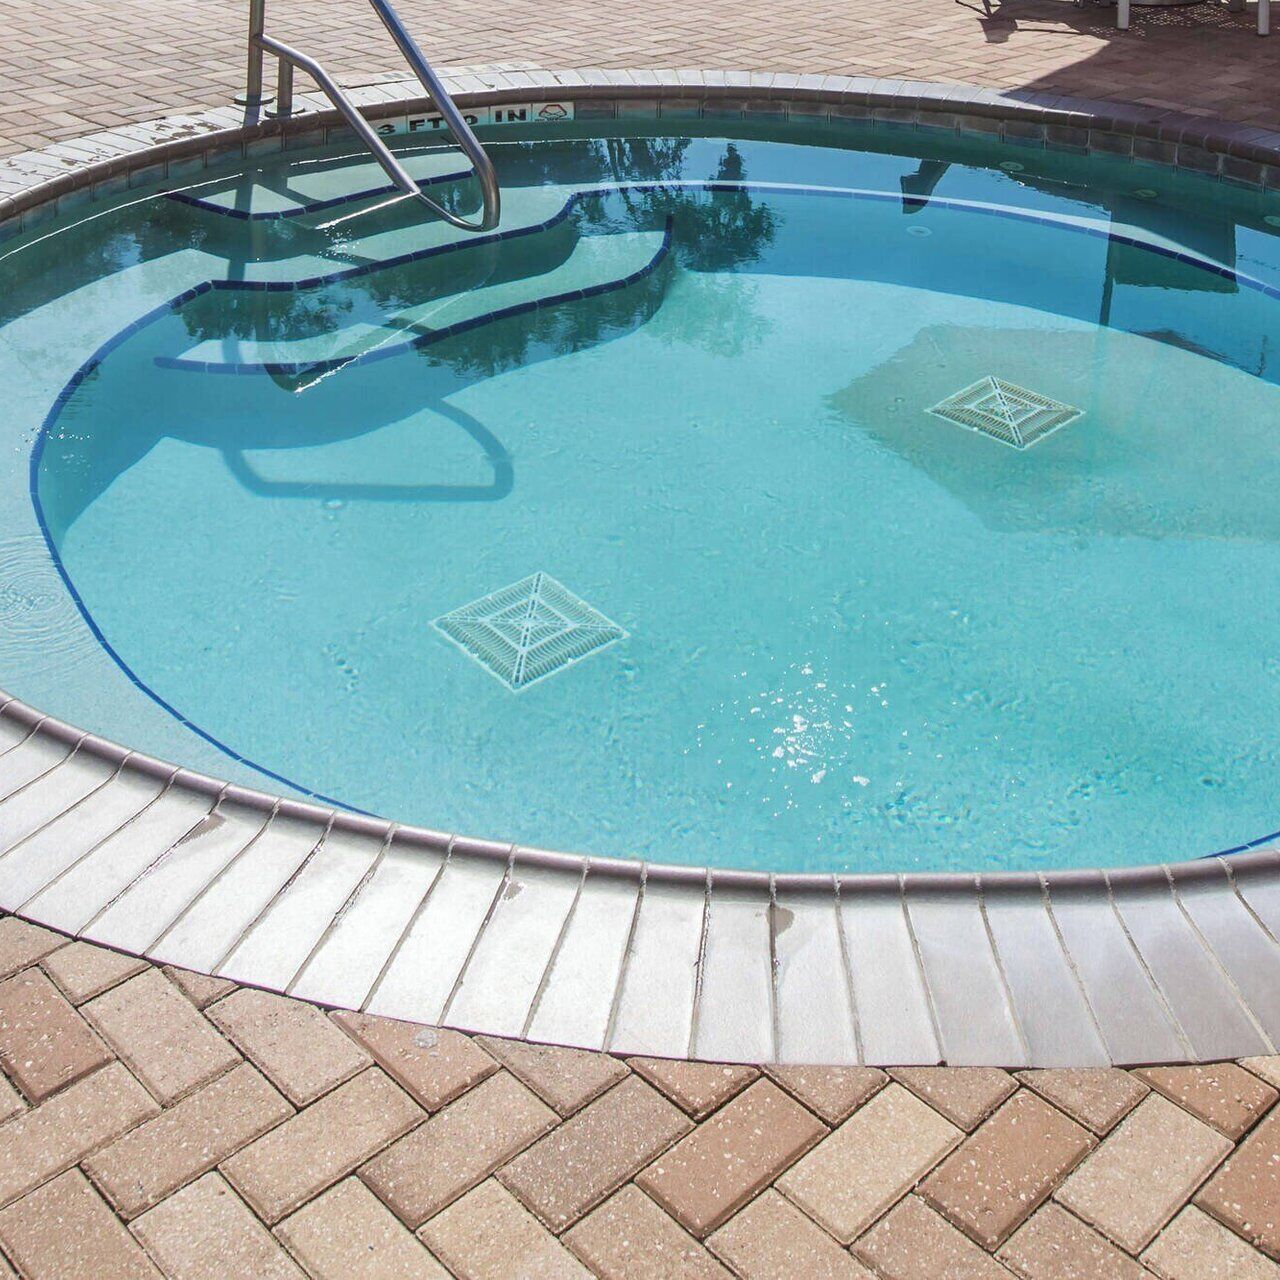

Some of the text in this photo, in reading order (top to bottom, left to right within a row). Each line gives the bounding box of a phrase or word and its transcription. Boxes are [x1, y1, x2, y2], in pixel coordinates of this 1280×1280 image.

[378, 124, 396, 134] 3
[410, 117, 443, 132] FT
[495, 109, 526, 122] IN
